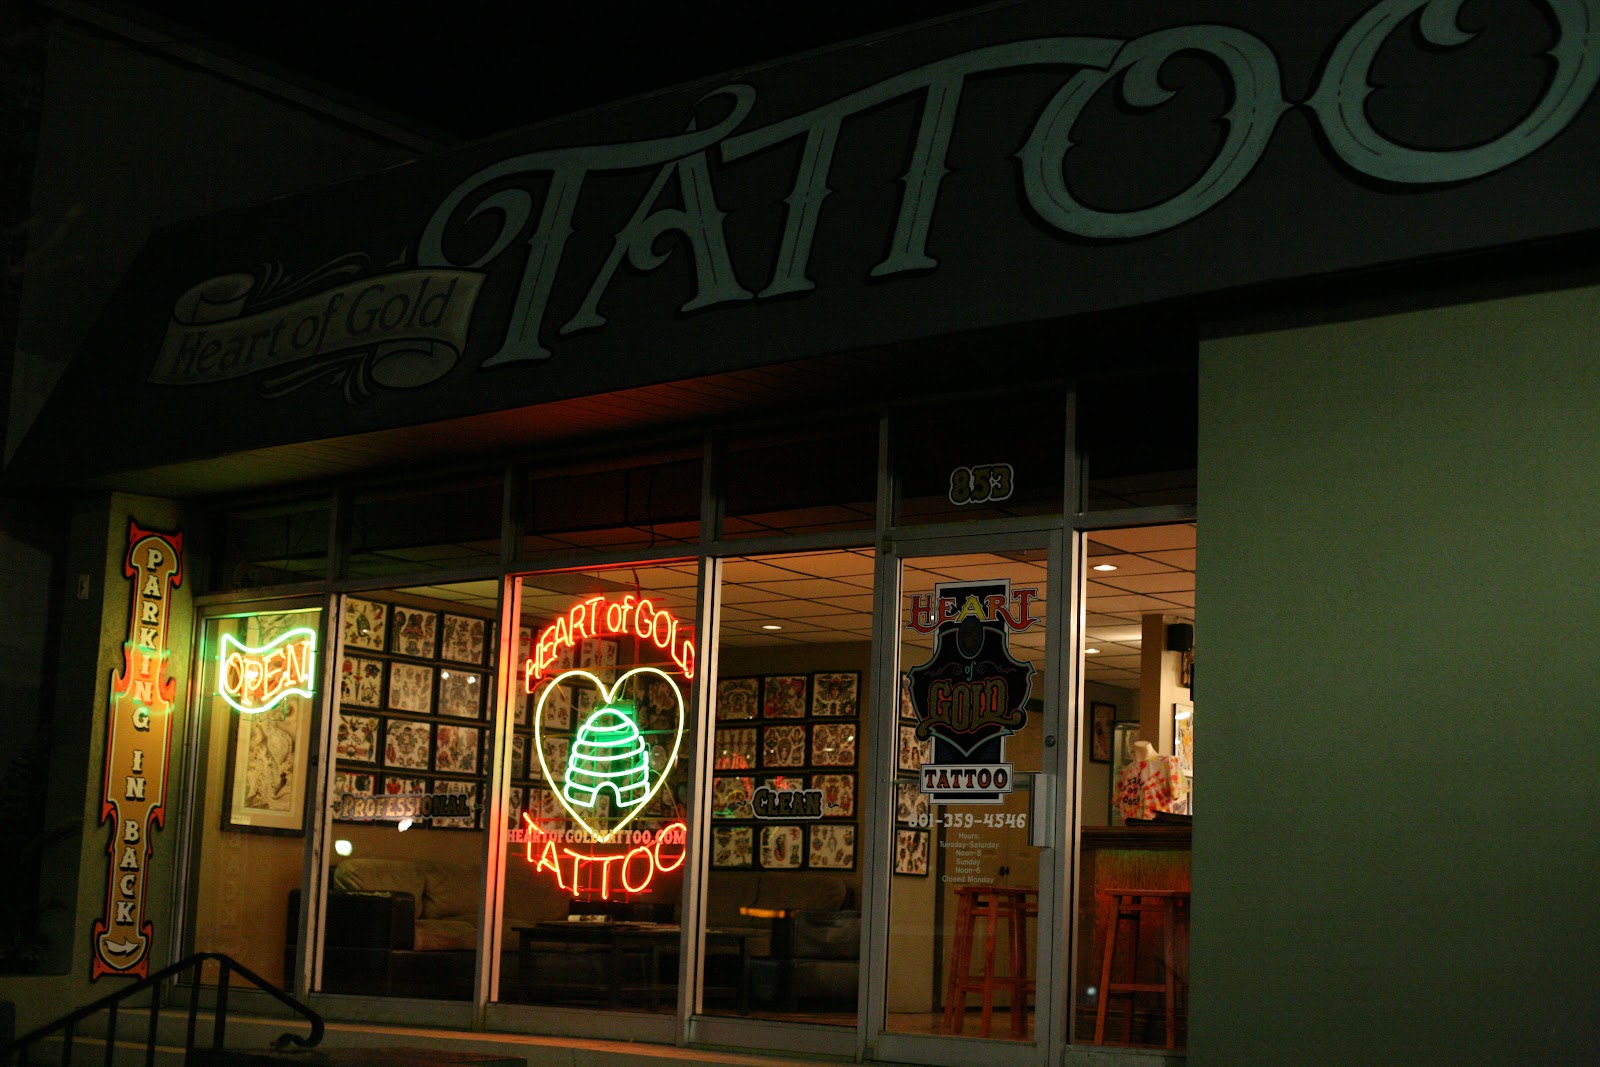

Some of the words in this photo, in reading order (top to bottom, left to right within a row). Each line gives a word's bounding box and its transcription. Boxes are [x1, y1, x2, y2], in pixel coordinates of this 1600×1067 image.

[417, 0, 1600, 370] TATTOO
[167, 316, 288, 375] Heart
[291, 291, 345, 354] of
[346, 275, 460, 337] Gold
[950, 464, 1014, 504] 853
[905, 587, 1041, 635] HEART
[132, 548, 163, 732] PARKING
[525, 596, 606, 695] HEART
[634, 599, 697, 680] GOLD
[223, 640, 312, 707] OPEN
[964, 660, 977, 682] of
[918, 676, 1024, 738] GOLD
[125, 750, 146, 800] IN
[924, 768, 1009, 790] TATTOO
[341, 793, 471, 818] PROFESSIONAL
[752, 788, 823, 818] CLEAN
[908, 812, 1027, 828] 801-359-4546
[523, 811, 687, 900] TATTOO
[939, 840, 1000, 850] Tuesday-Saturday
[958, 832, 980, 840] Hours:
[116, 819, 140, 926] BACK
[941, 875, 965, 883] Closed
[967, 876, 994, 884] Monday
[955, 858, 981, 866] Sunday
